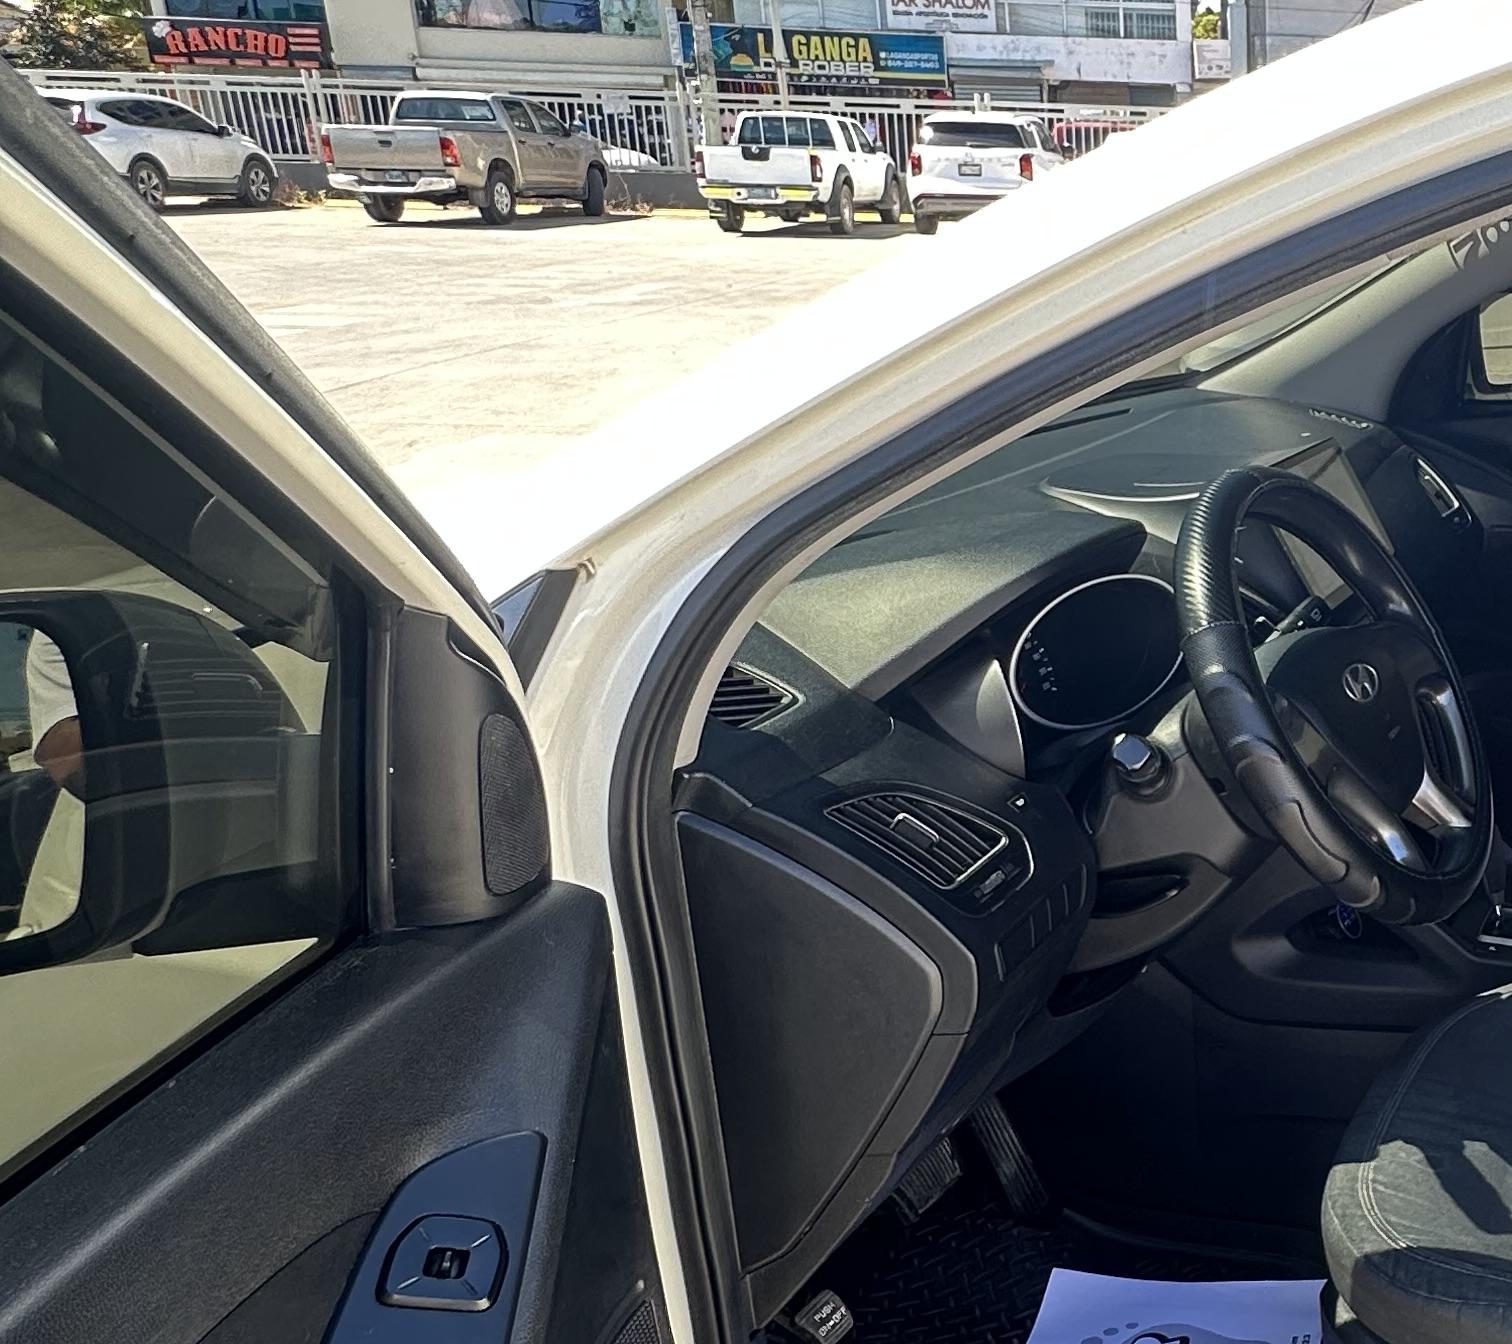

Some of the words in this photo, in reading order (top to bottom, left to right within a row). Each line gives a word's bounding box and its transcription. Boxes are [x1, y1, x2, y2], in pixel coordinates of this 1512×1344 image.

[165, 26, 286, 58] RANCHO
[791, 34, 873, 62] GANGA
[798, 59, 875, 77] ROBER
[814, 1302, 836, 1323] PUSH
